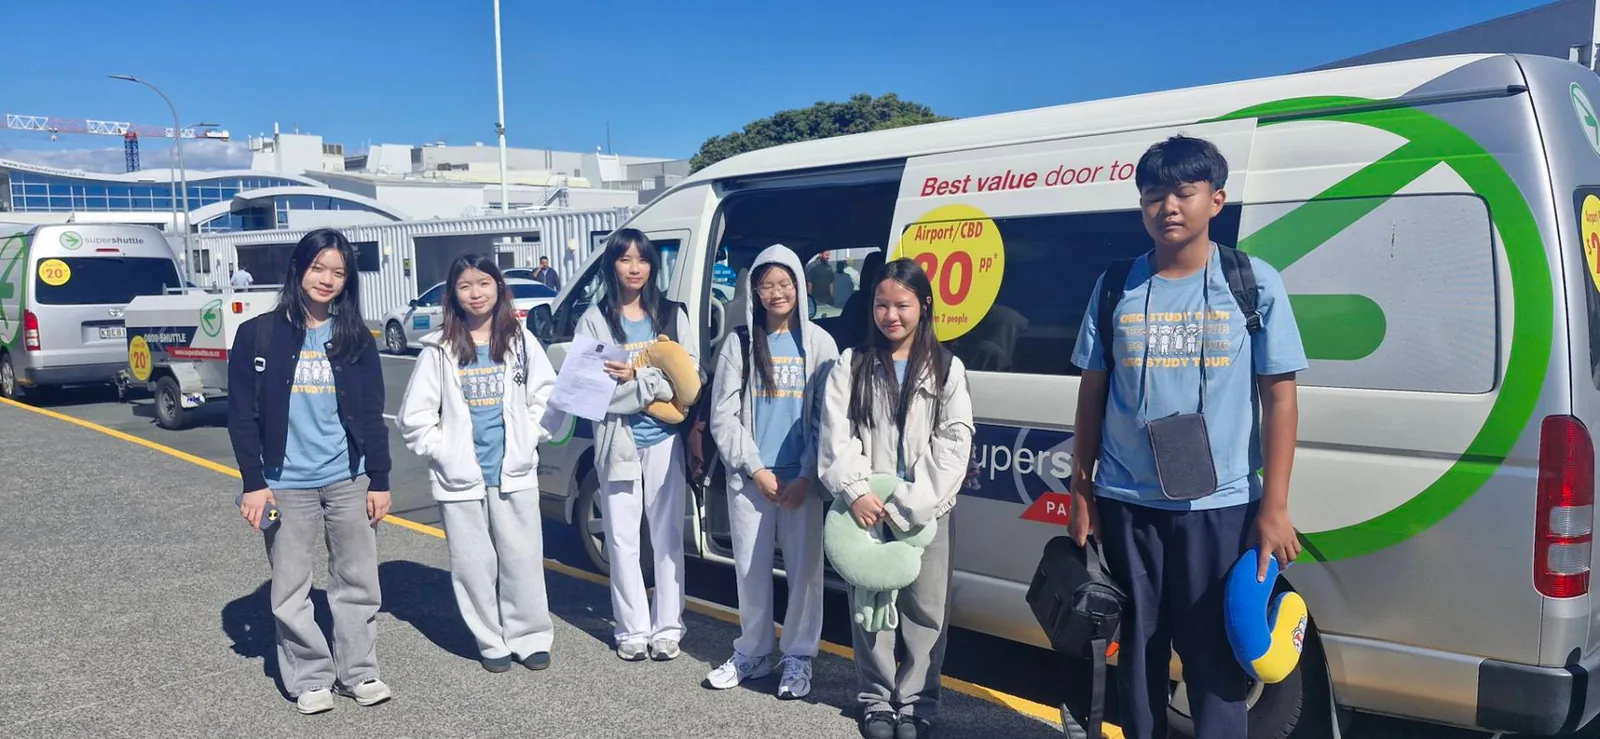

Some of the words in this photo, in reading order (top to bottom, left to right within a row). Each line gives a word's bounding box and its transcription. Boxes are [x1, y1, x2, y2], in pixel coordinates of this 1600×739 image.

[920, 174, 971, 197] Best
[977, 169, 1037, 193] value
[1045, 164, 1103, 187] door
[1109, 160, 1134, 181] to
[914, 219, 983, 244] Airport/CBD
[84, 236, 144, 247] supershuttle
[941, 313, 946, 323] 2
[947, 313, 968, 325] people
[1148, 311, 1190, 322] STUDY
[1146, 356, 1190, 368] STUDY
[1046, 501, 1067, 517] PA
